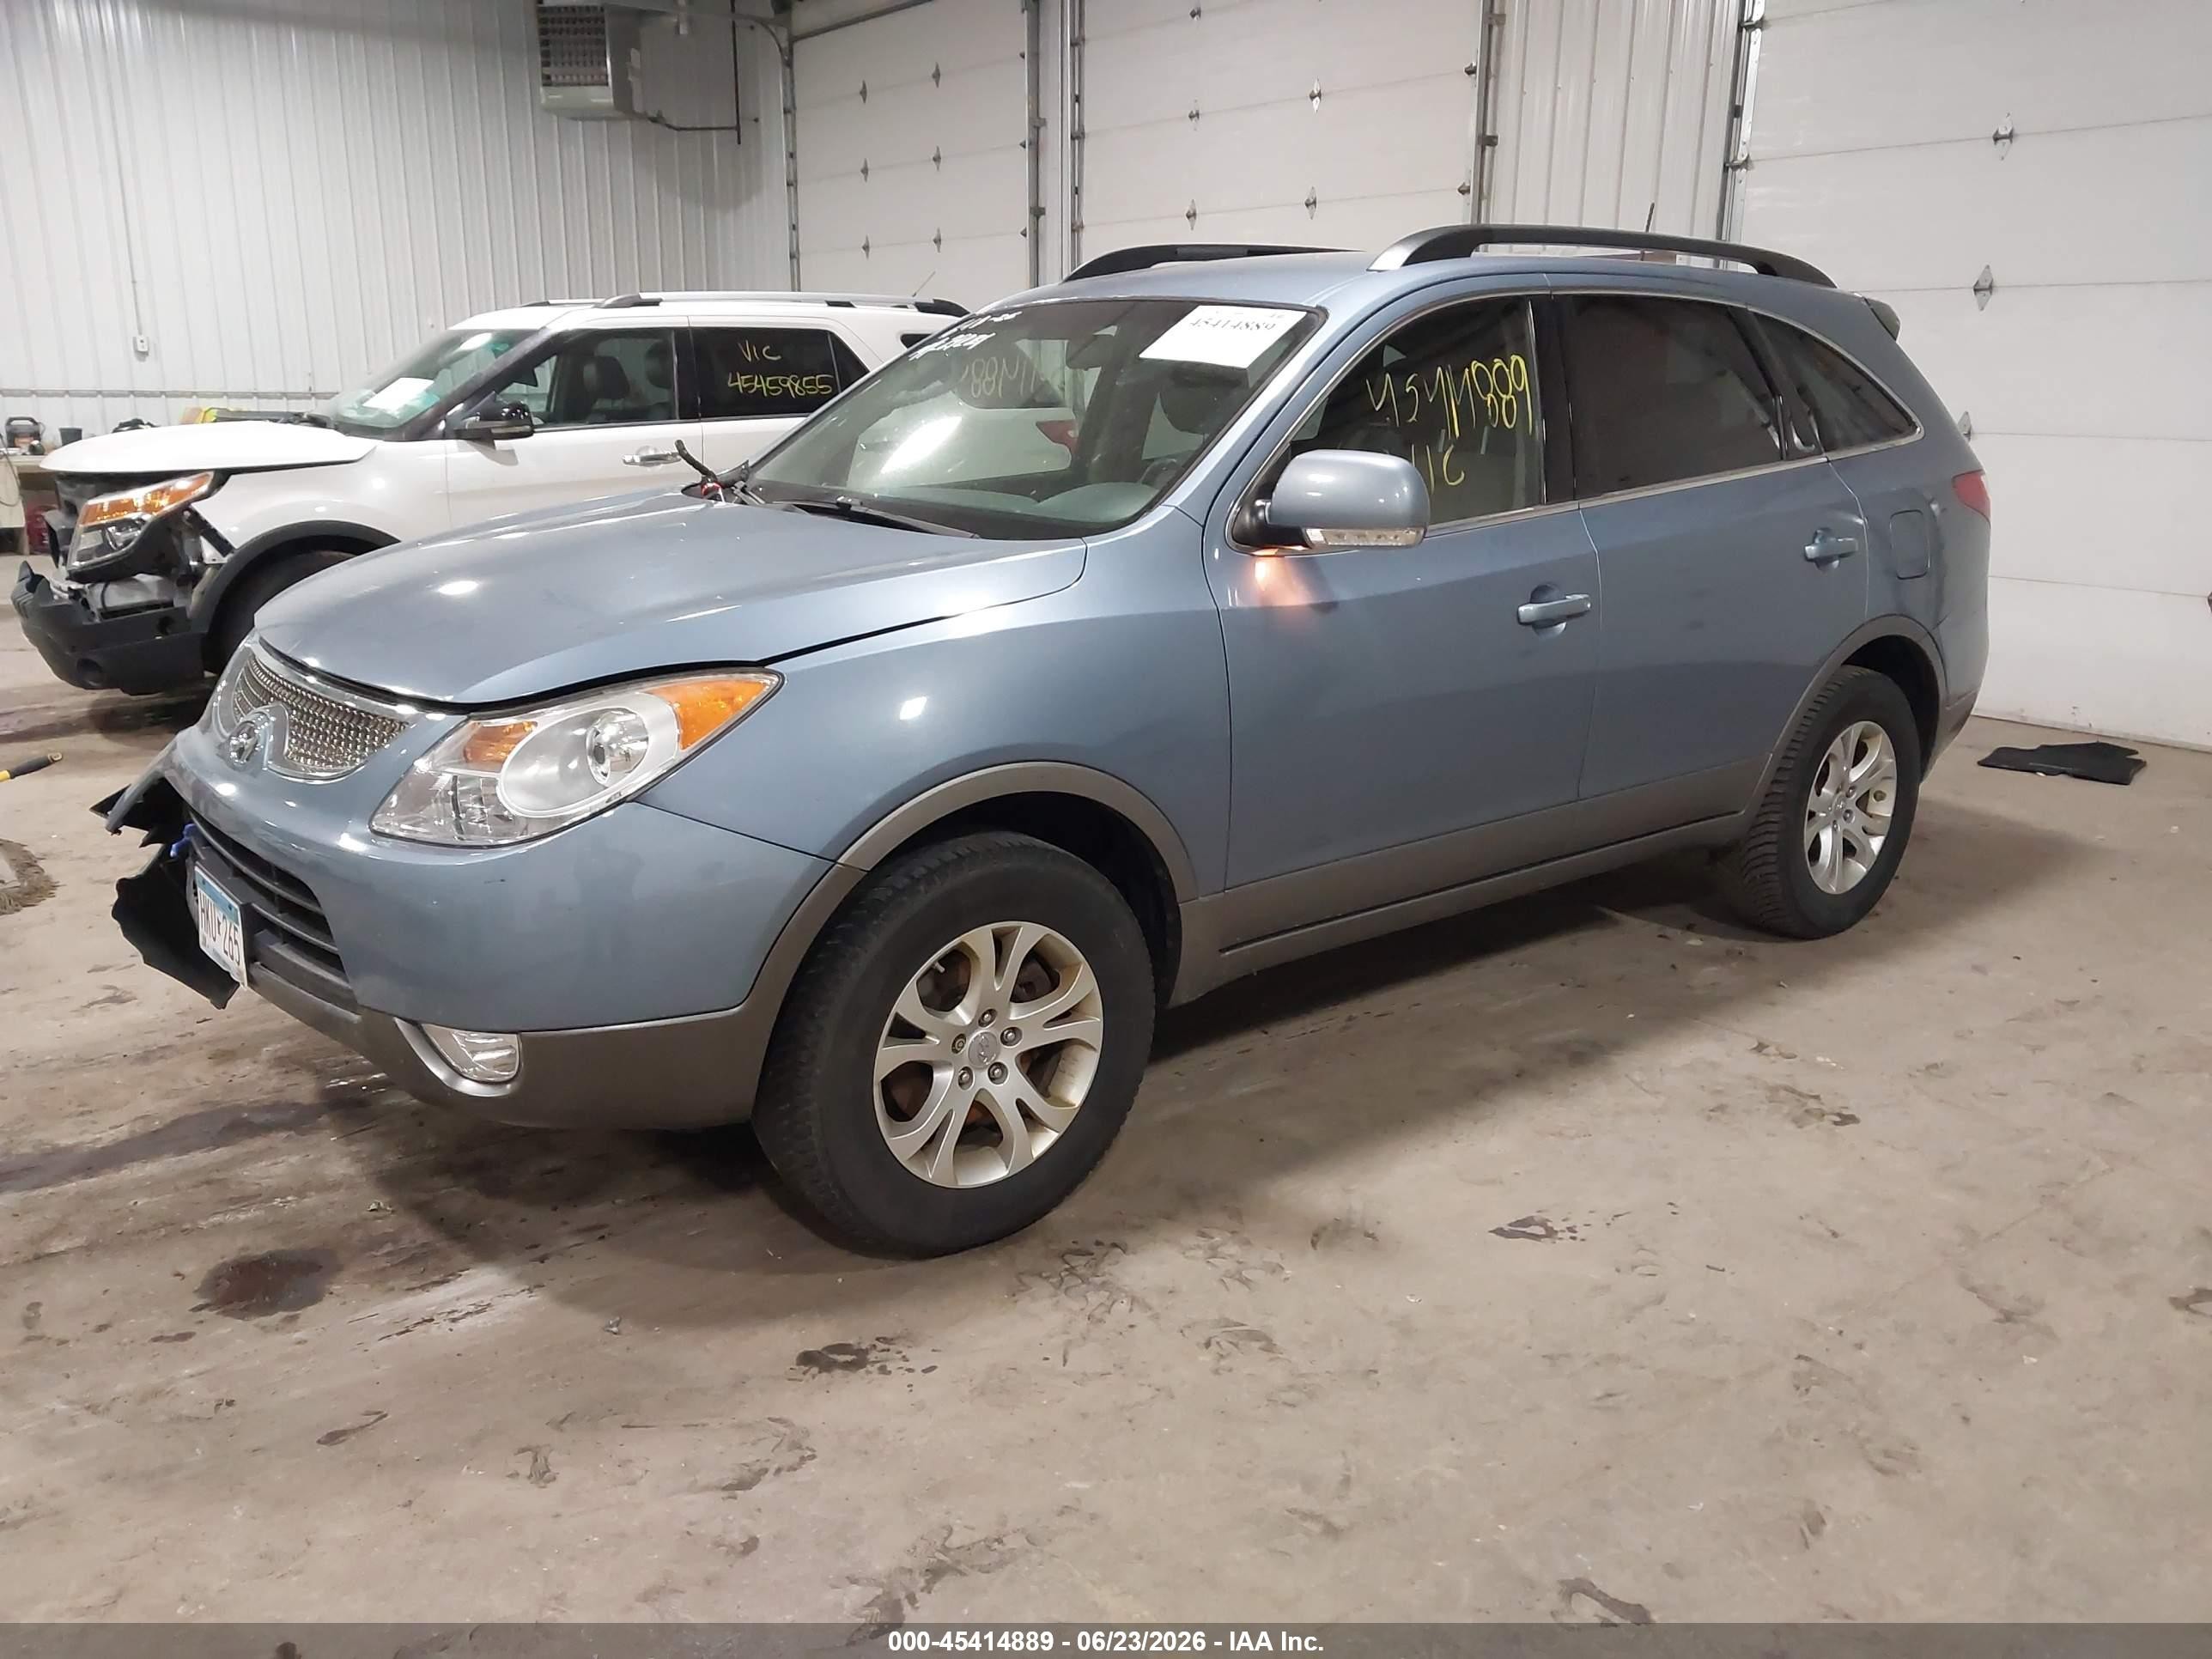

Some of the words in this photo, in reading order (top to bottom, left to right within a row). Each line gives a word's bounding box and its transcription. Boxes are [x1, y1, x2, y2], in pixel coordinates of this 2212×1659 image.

[738, 340, 781, 362] VIC
[727, 372, 833, 398] 45459855
[1366, 355, 1533, 439] 45414889
